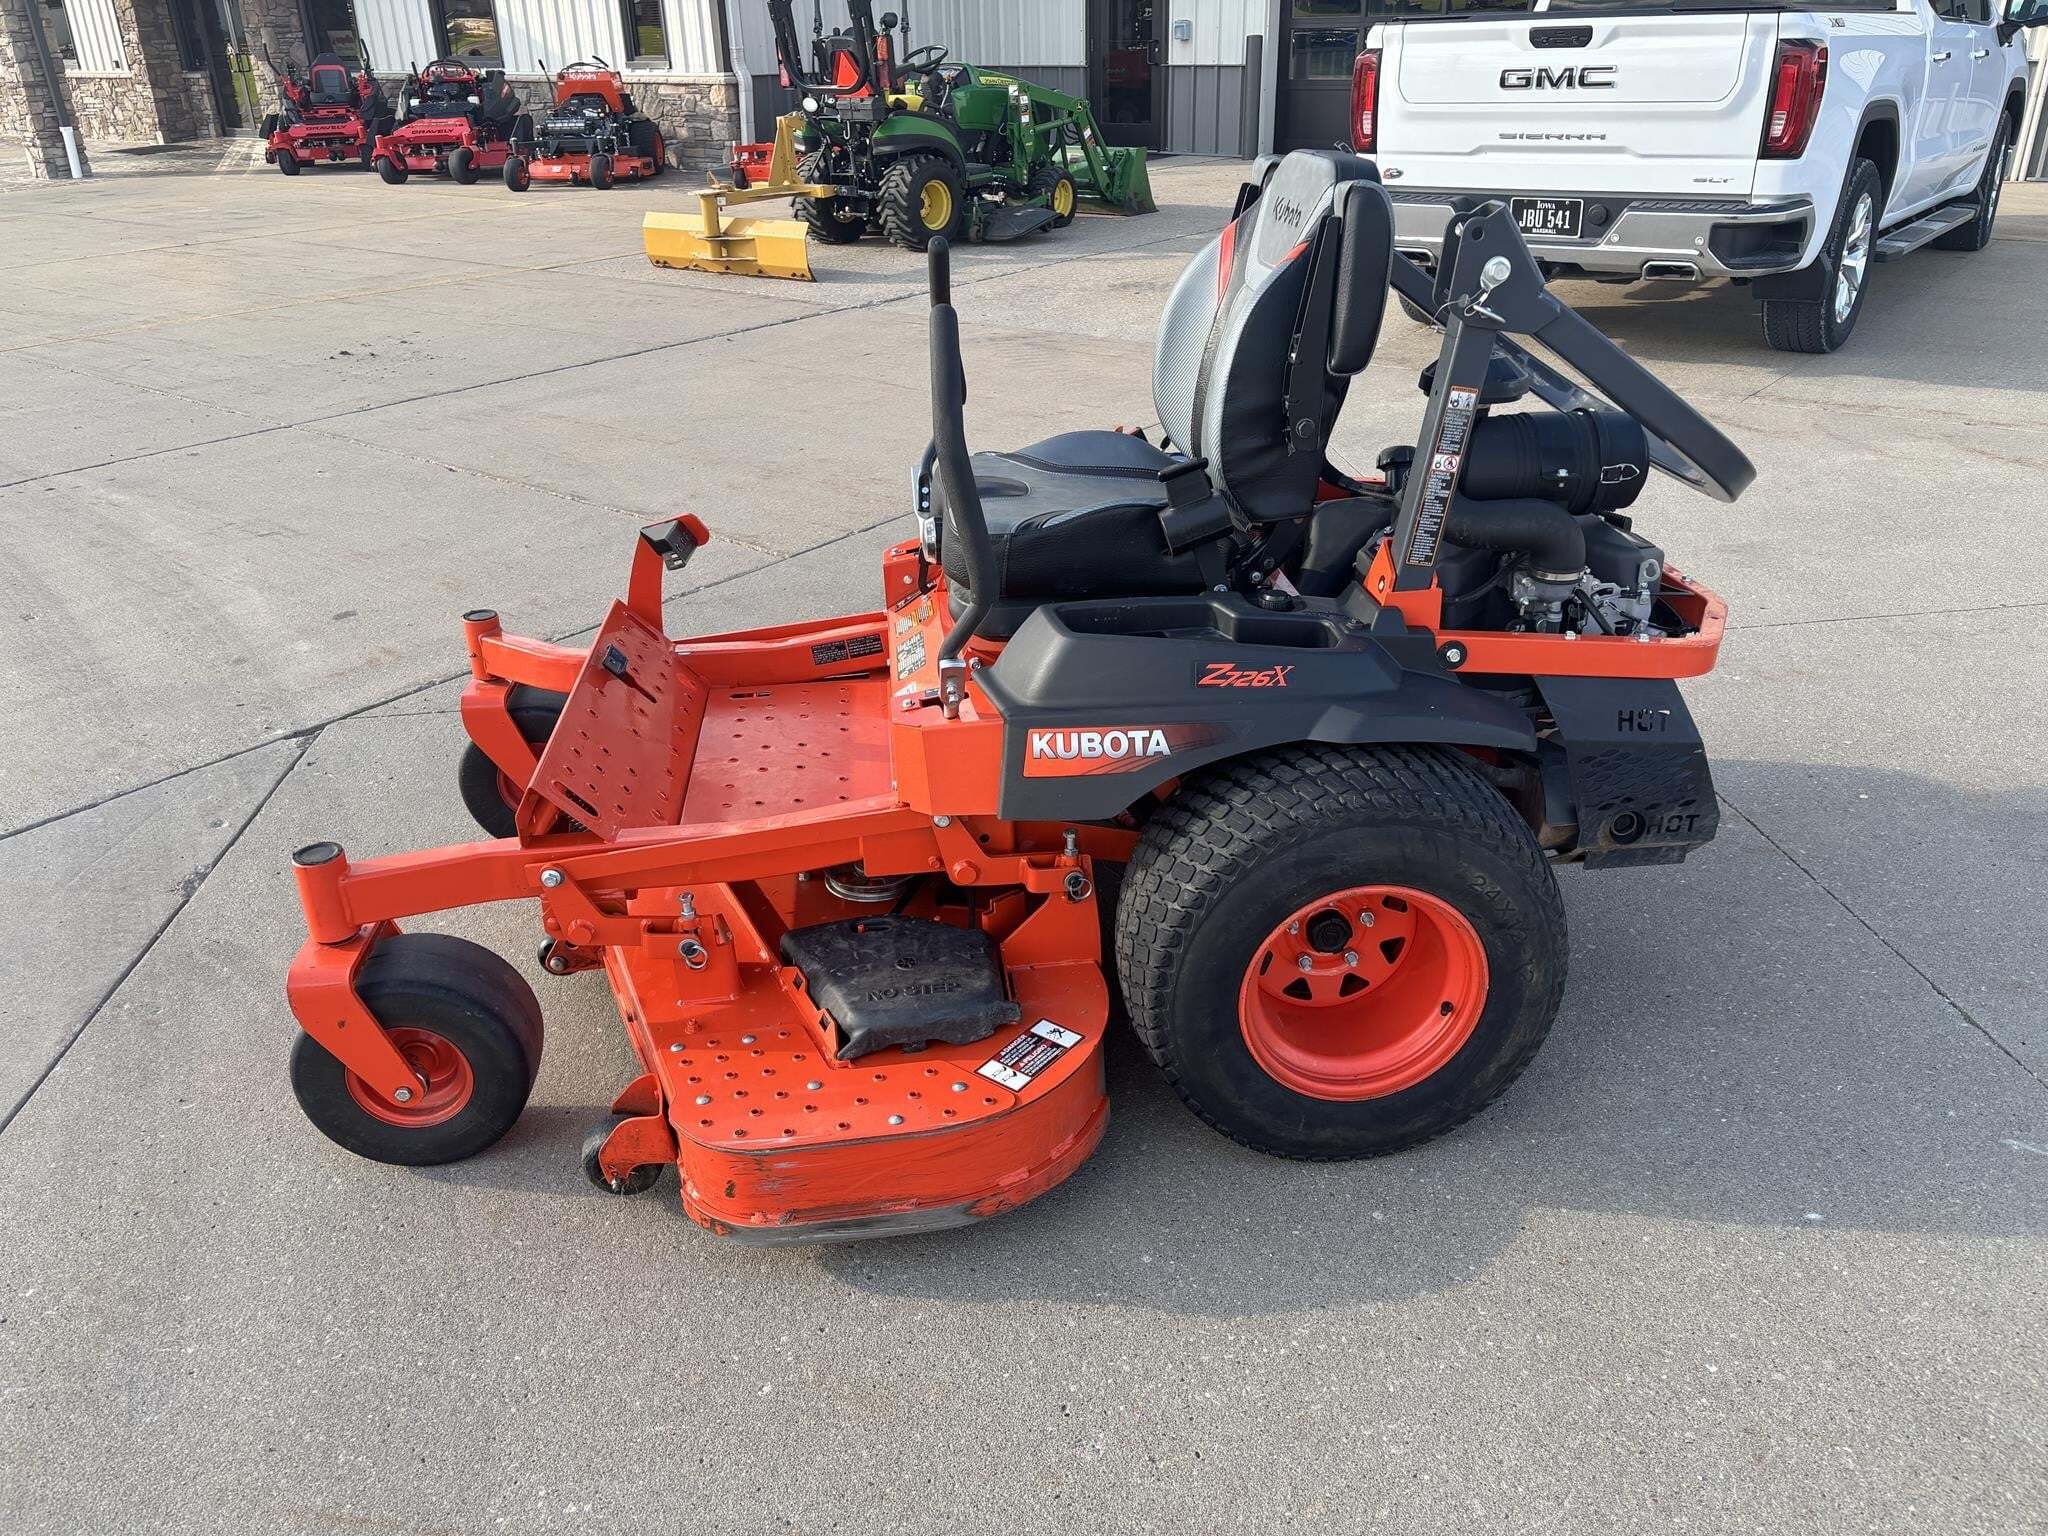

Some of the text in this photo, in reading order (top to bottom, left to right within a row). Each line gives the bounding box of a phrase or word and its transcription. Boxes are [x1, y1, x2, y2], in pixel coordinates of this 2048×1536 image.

[1499, 65, 1618, 91] GMC
[1498, 132, 1606, 141] SIERRA
[1691, 176, 1736, 184] SLT
[1272, 195, 1302, 228] Kubota
[1519, 209, 1571, 229] JBU 541
[1532, 227, 1557, 235] MARSHALL
[1198, 663, 1295, 688] Z726X
[1617, 709, 1671, 733] HOT
[1031, 729, 1173, 760] KUBOTA
[1646, 814, 1701, 836] HOT
[865, 982, 961, 1002] NO STEP
[1003, 1034, 1027, 1053] DANGER
[1023, 1044, 1048, 1064] PELIGRO
